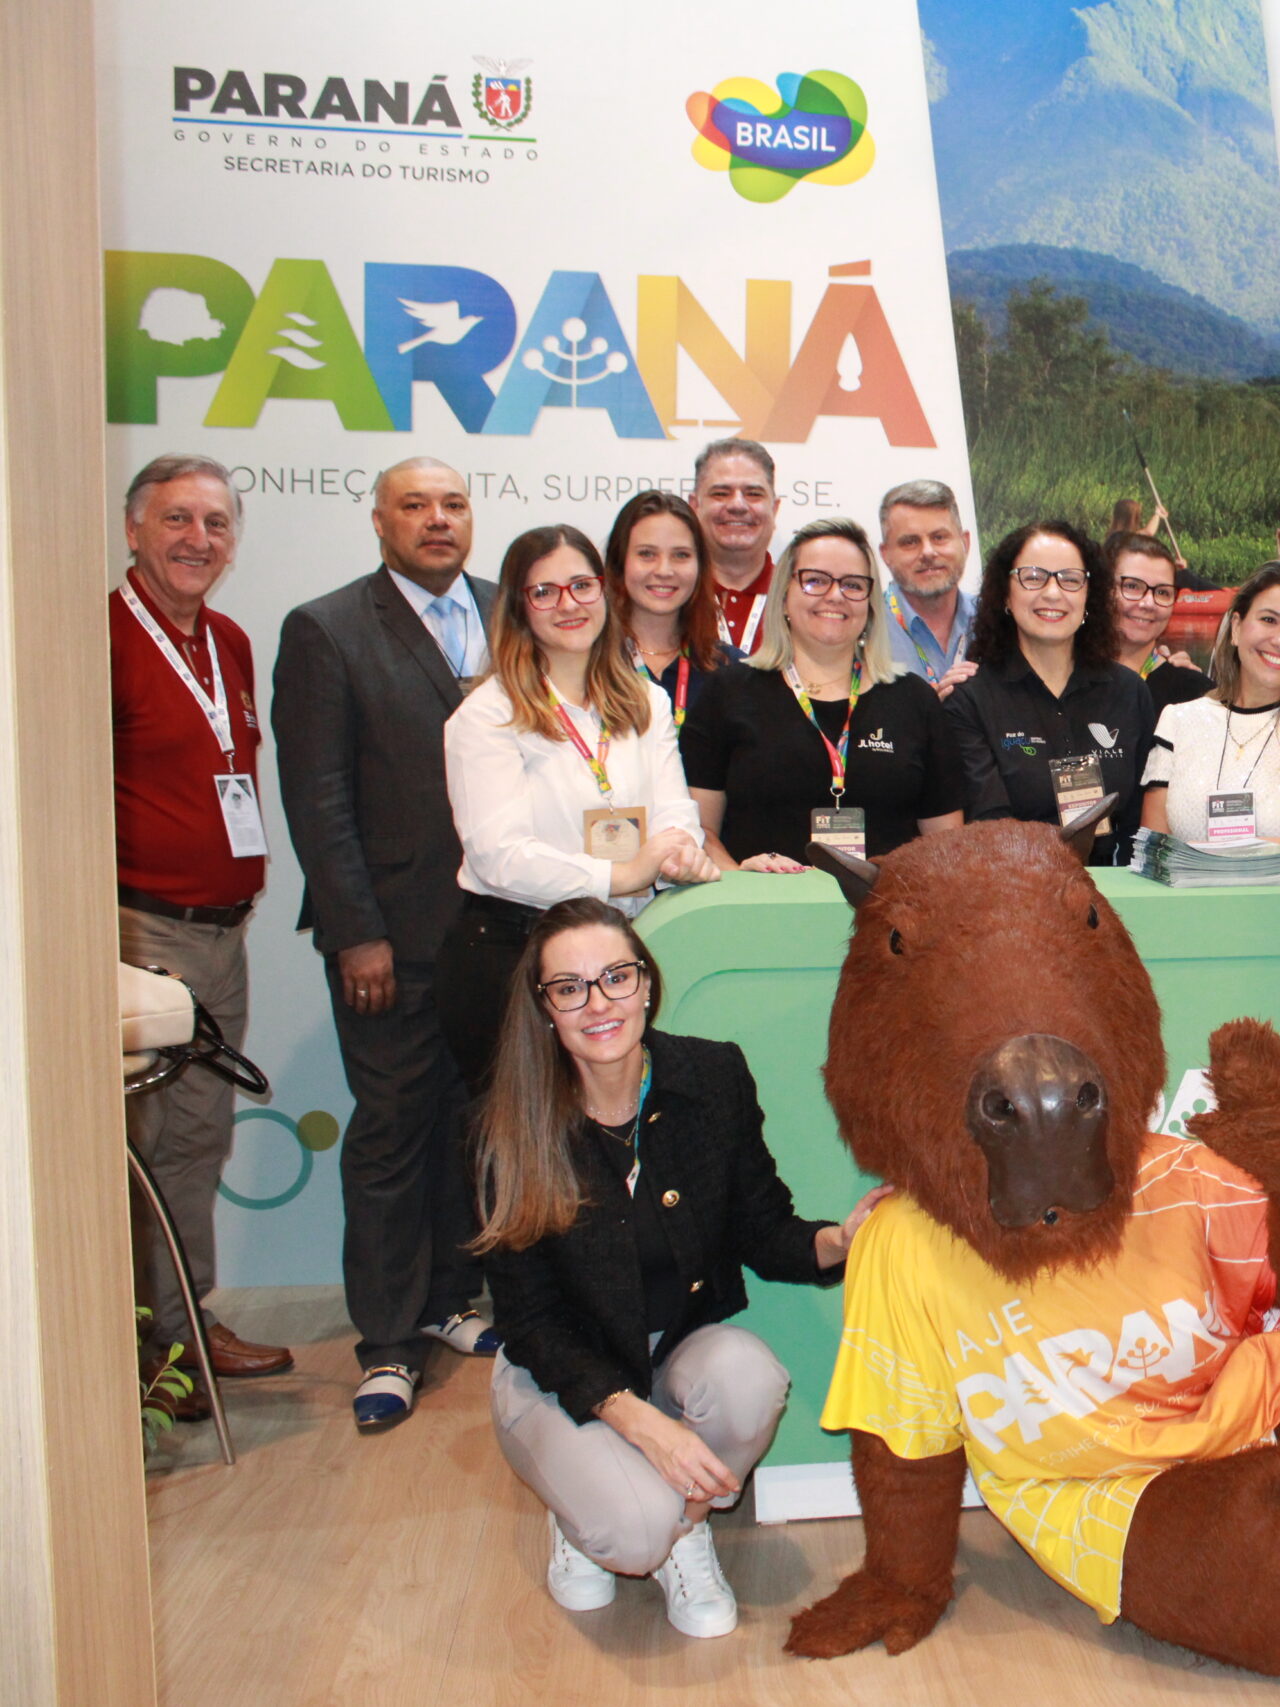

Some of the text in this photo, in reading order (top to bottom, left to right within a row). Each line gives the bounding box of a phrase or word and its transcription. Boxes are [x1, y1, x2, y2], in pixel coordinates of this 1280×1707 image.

[173, 66, 462, 128] PARANÁ
[174, 129, 539, 162] GOVERNO DO ESTADO
[736, 121, 837, 153] BRASIL
[223, 155, 490, 185] SECRETARIA DO TURISMO
[104, 249, 938, 449] PARANÁ
